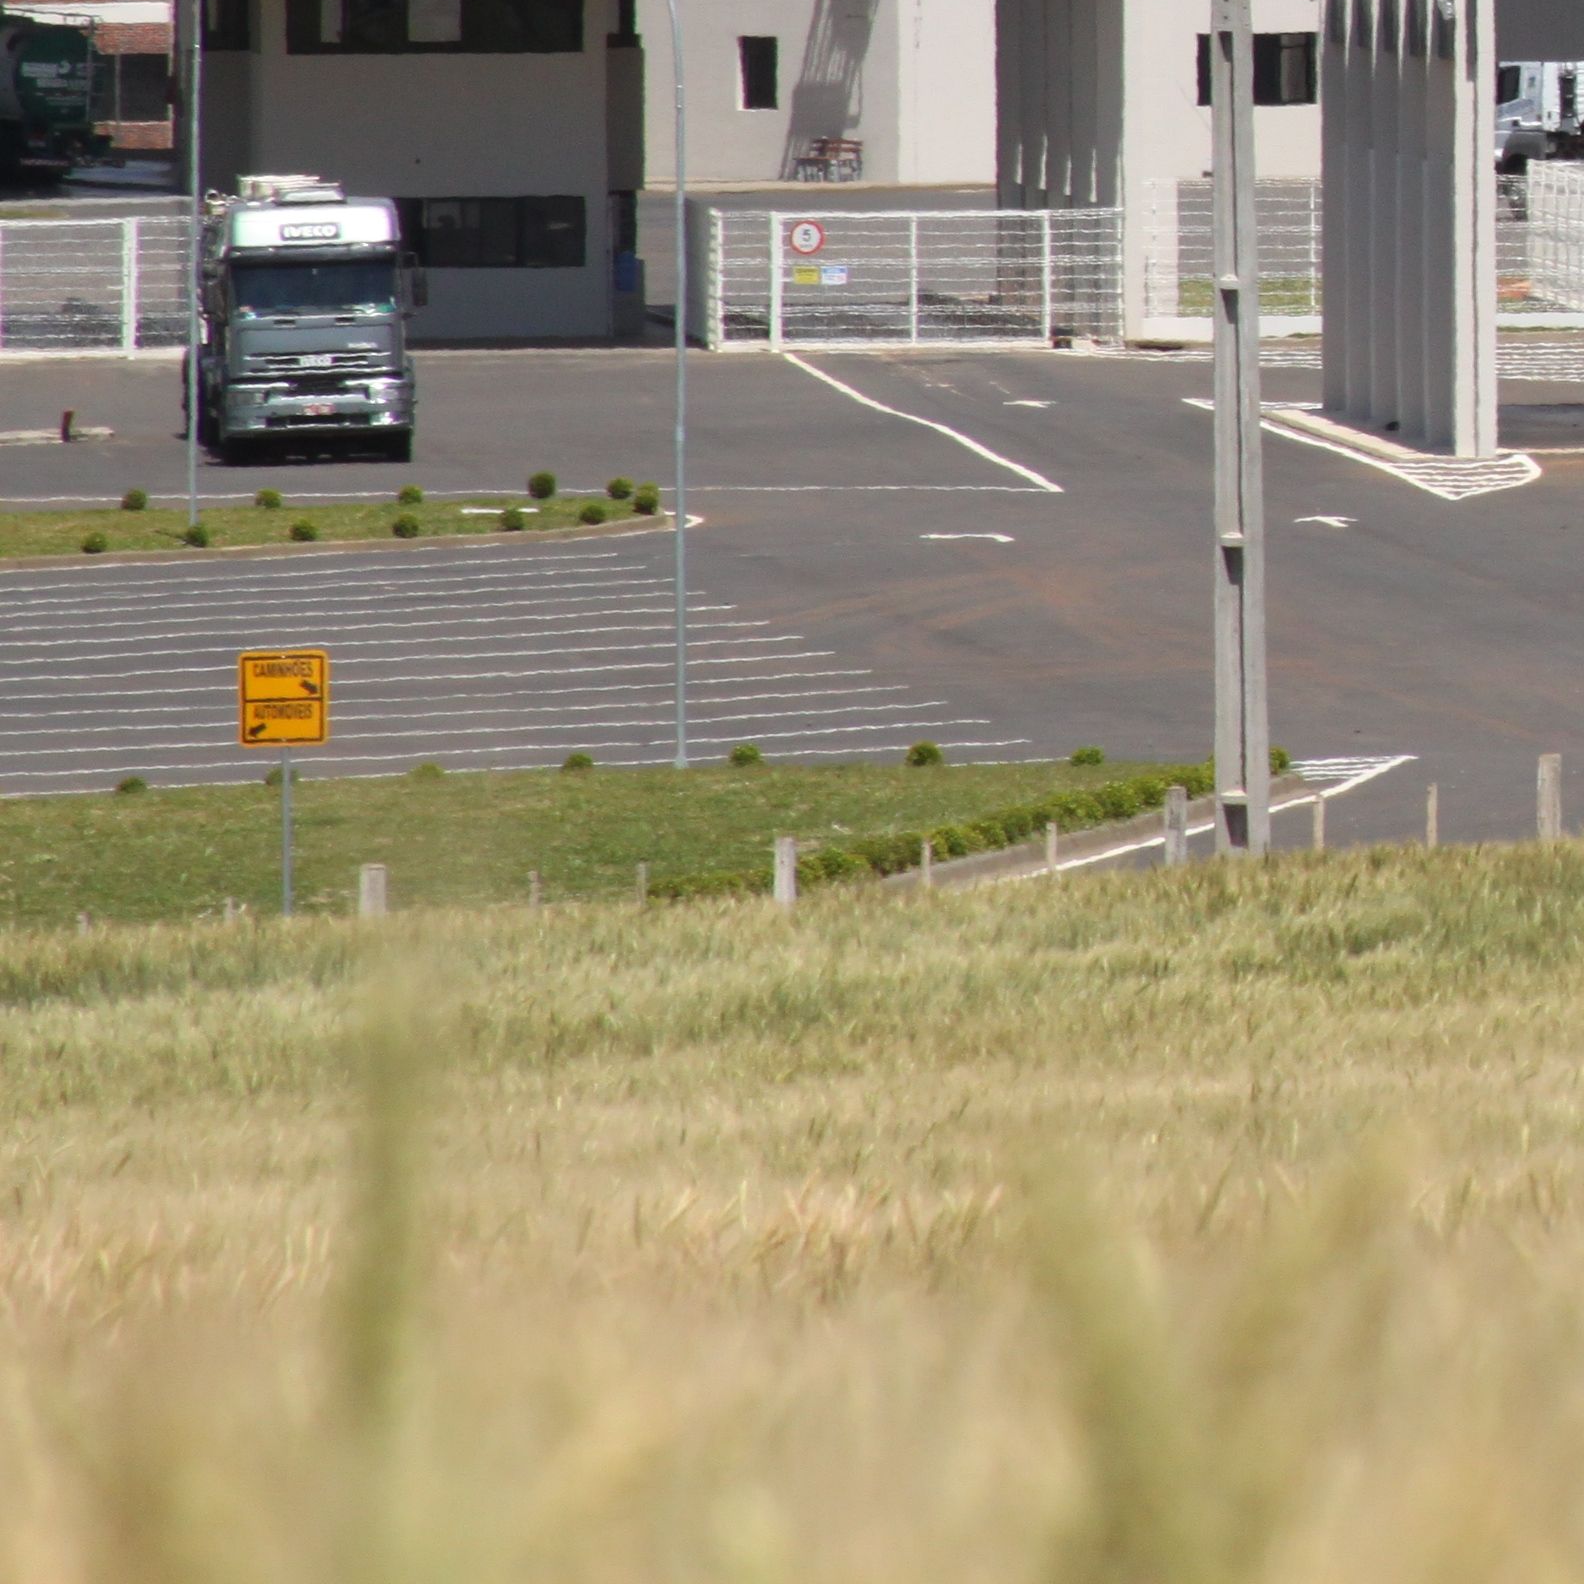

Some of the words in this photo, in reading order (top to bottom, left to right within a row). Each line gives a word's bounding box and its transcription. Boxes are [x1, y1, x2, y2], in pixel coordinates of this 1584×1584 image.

[283, 224, 337, 238] IVECO
[802, 228, 812, 242] 5
[253, 659, 314, 677] CAMINHÕES
